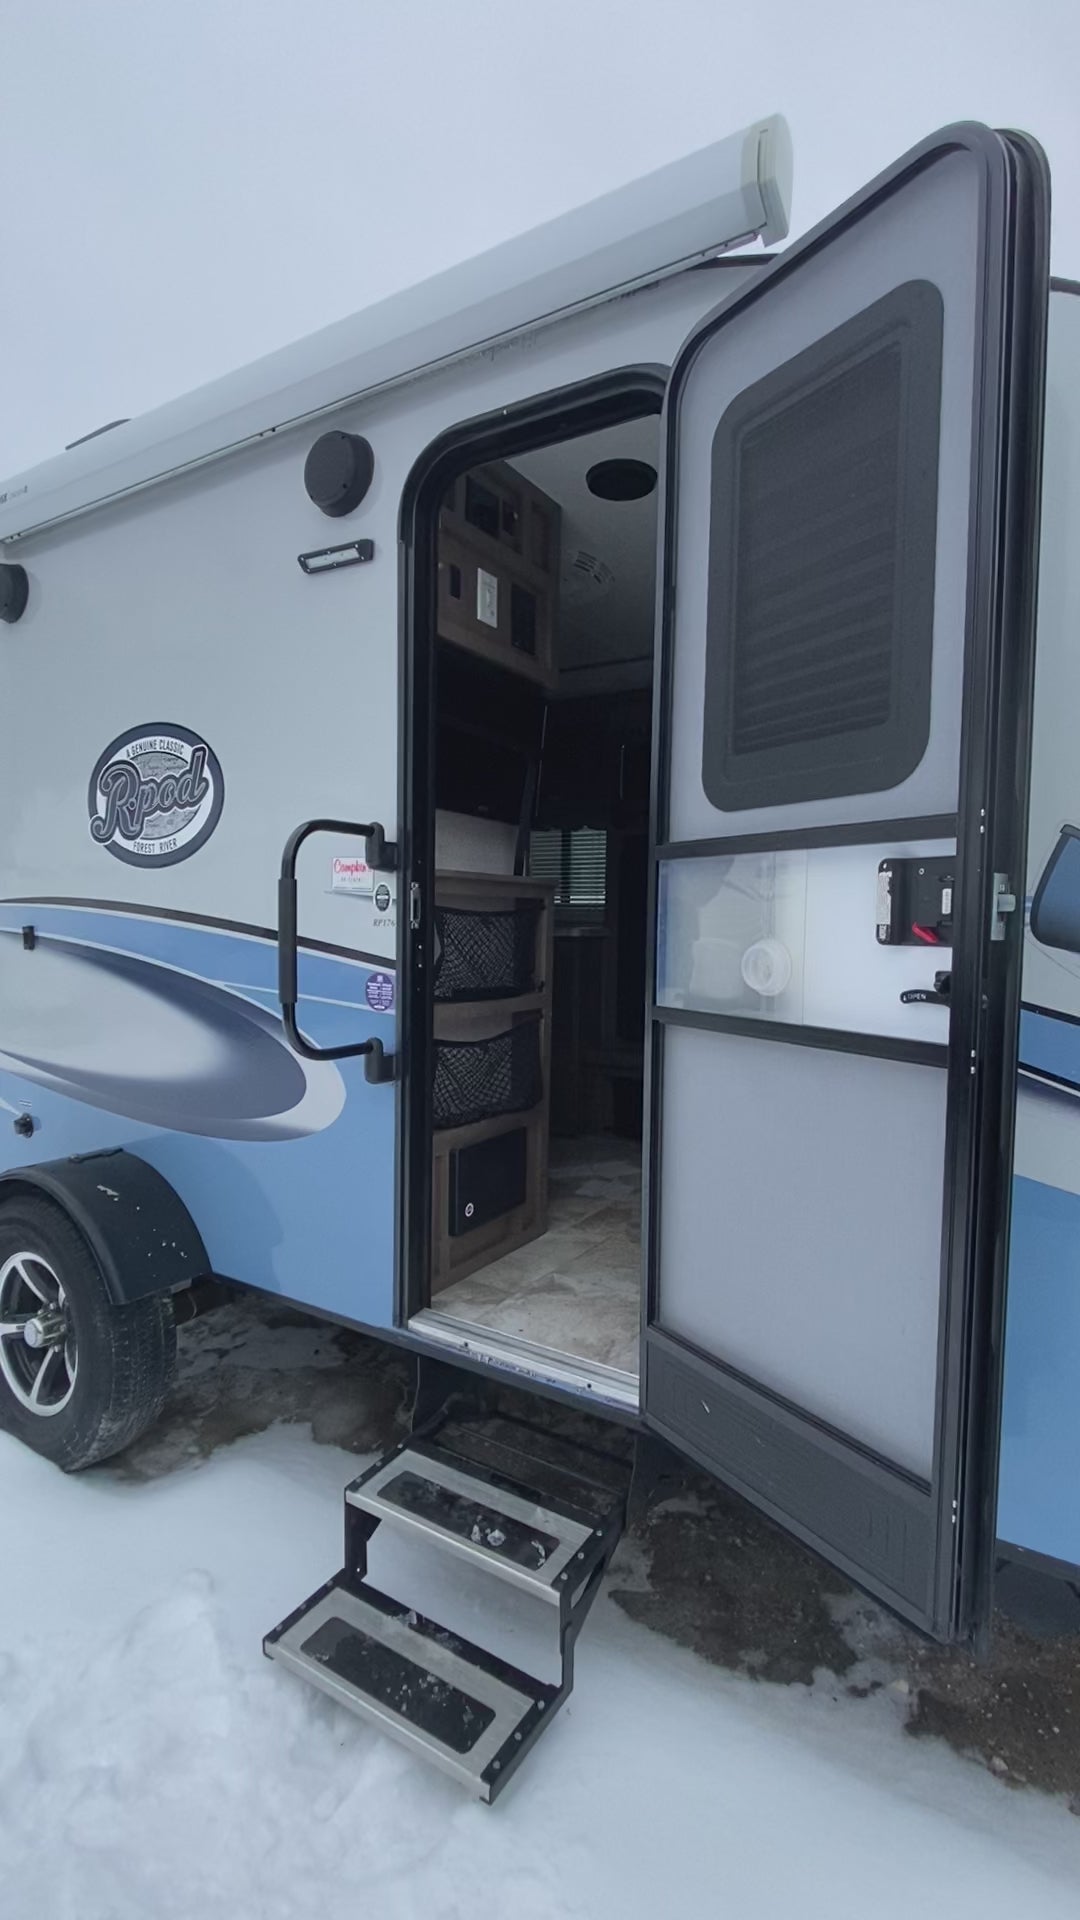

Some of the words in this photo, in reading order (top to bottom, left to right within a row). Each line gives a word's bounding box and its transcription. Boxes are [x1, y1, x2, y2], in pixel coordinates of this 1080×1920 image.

[131, 740, 157, 756] GENUINE
[159, 739, 185, 754] CLASSIC
[133, 841, 155, 854] FOREST
[159, 838, 178, 852] RIVER
